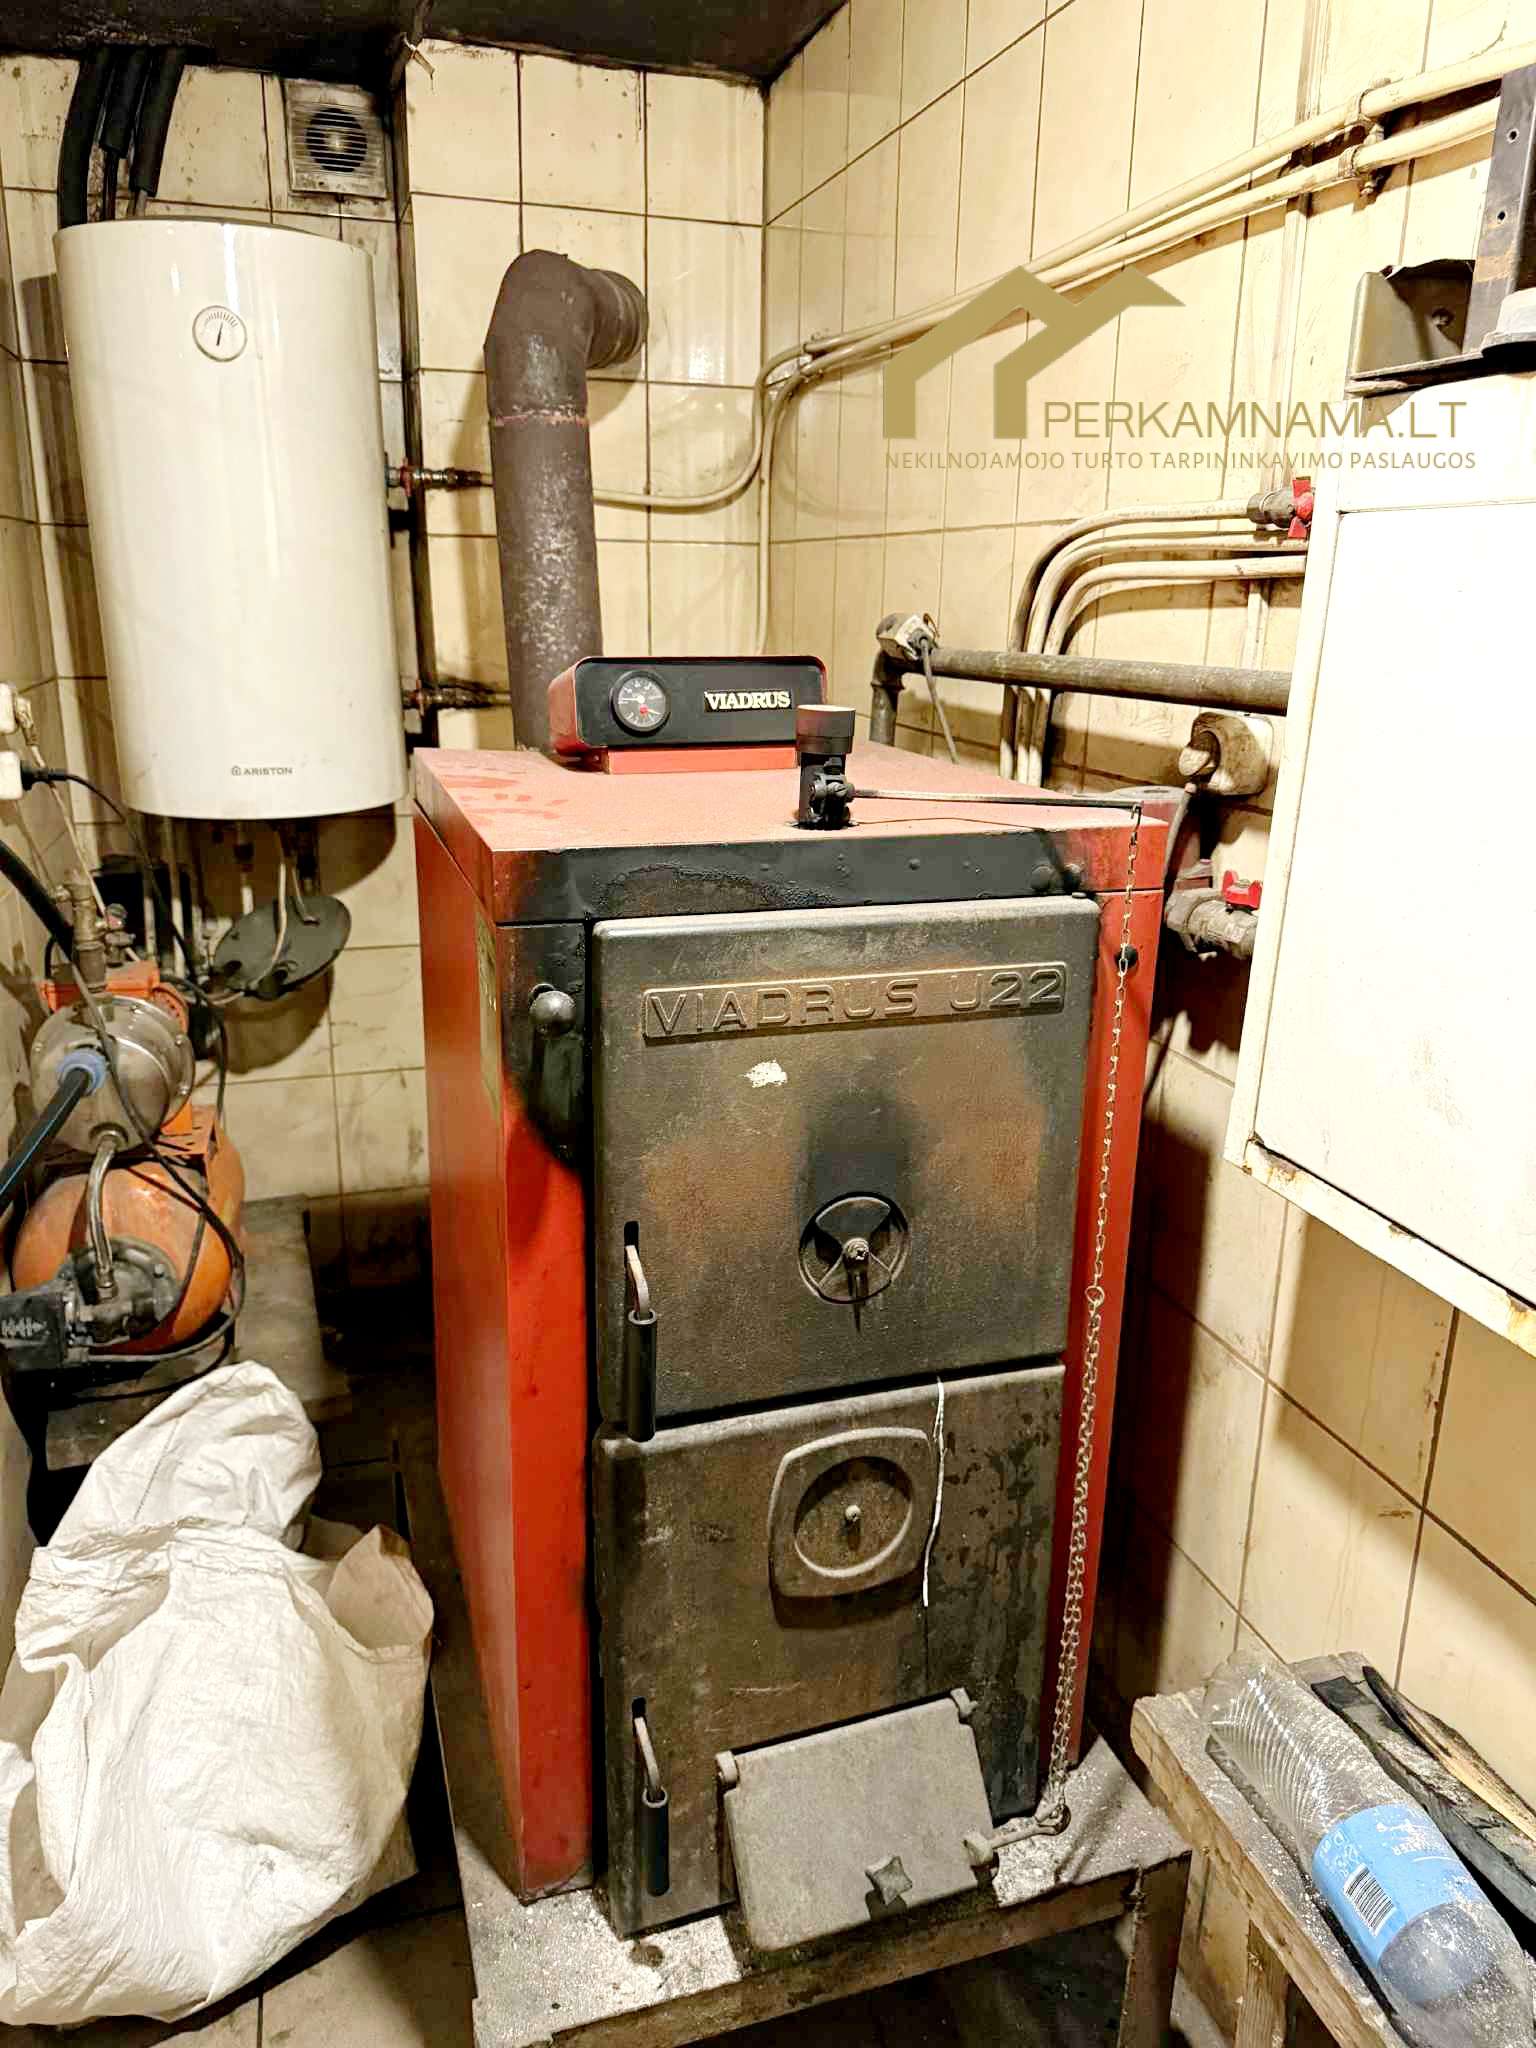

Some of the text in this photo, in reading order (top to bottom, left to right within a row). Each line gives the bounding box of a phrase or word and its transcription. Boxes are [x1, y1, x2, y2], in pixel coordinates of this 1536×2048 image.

[704, 690, 791, 711] VIADRUS
[243, 766, 294, 777] ARISTON
[648, 979, 919, 1034] VIADRUS
